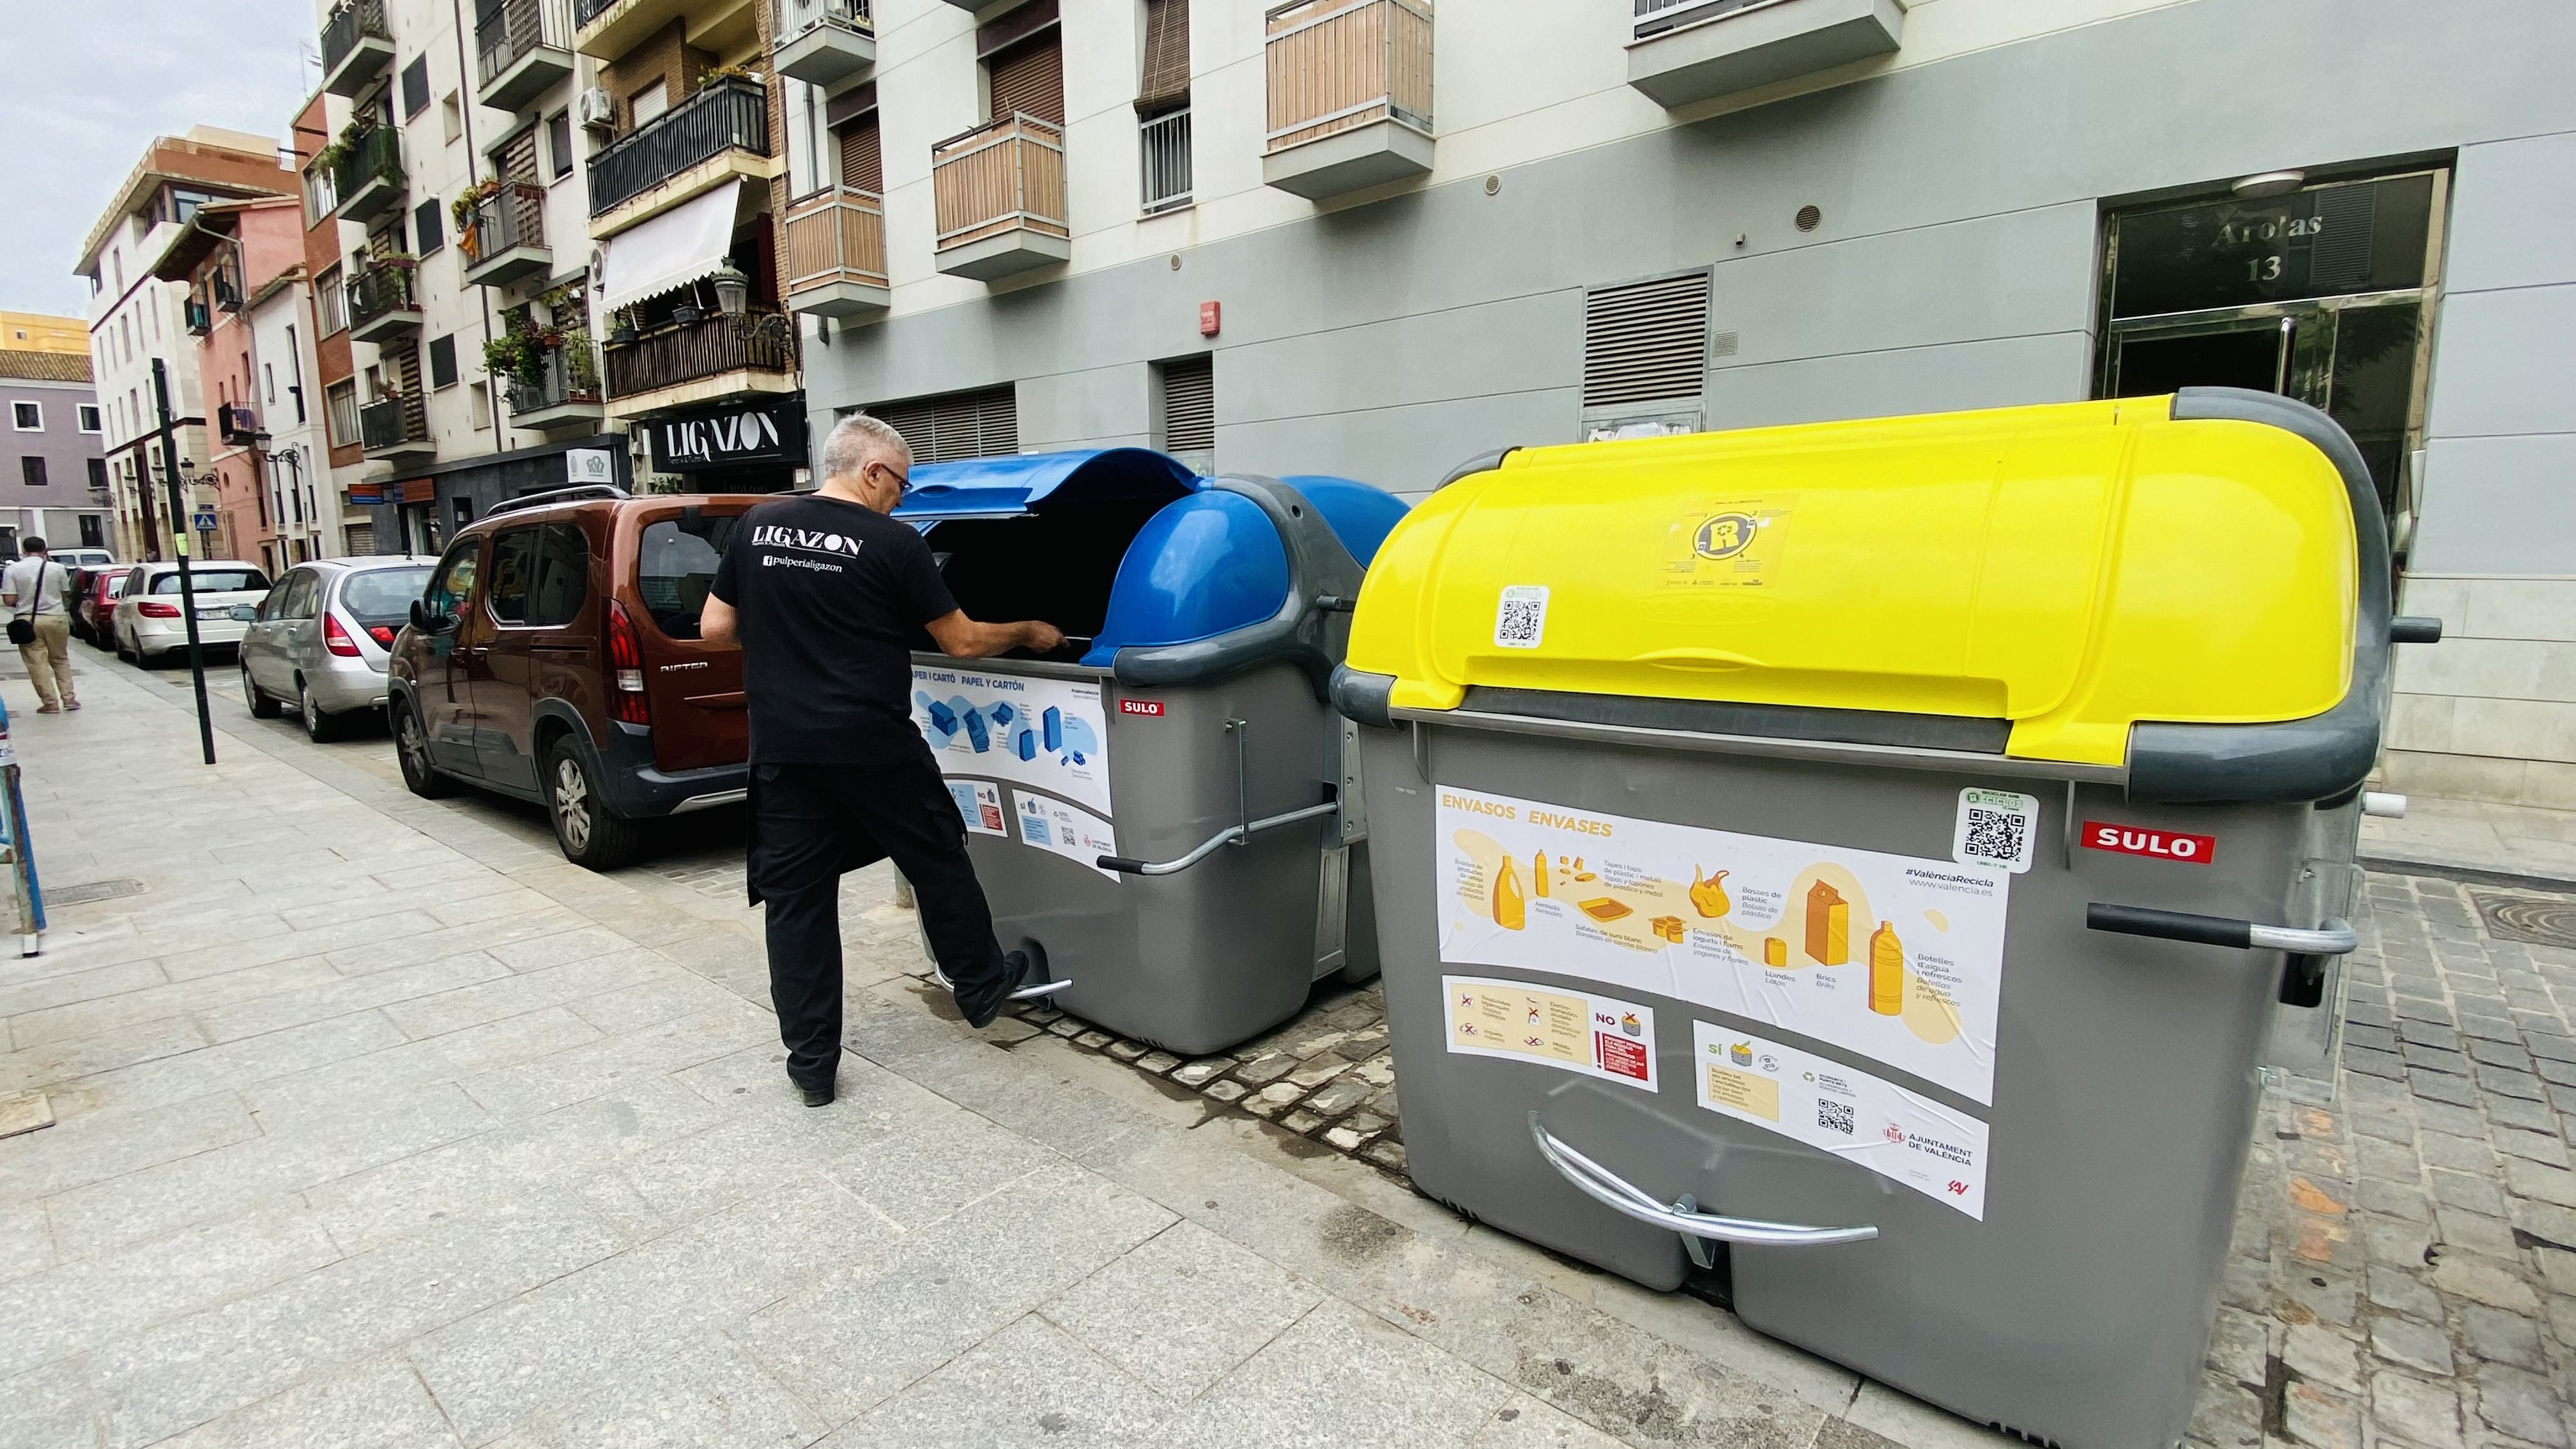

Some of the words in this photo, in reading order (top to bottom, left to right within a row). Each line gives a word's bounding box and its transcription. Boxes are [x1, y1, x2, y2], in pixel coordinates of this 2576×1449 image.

[2247, 256, 2281, 282] 13
[666, 410, 779, 463] LIGAZON
[752, 525, 864, 555] LIGAZON
[773, 555, 843, 573] pulperialigazon
[962, 676, 984, 687] PAPEL
[986, 678, 991, 687] Y
[992, 679, 1025, 691] CARTÓN
[1124, 702, 1158, 714] SULO
[1442, 793, 1516, 820] ENVASOS
[1528, 809, 1613, 838] ENVASES
[2096, 828, 2196, 857] SULO
[1908, 878, 1993, 897] www.valencia.es
[1918, 953, 1954, 966] Botelles
[1922, 970, 1963, 983] refrescos
[1595, 1013, 1615, 1025] NO
[1908, 1141, 1922, 1151] DE
[1909, 1133, 1973, 1158] AJUNTAMENT
